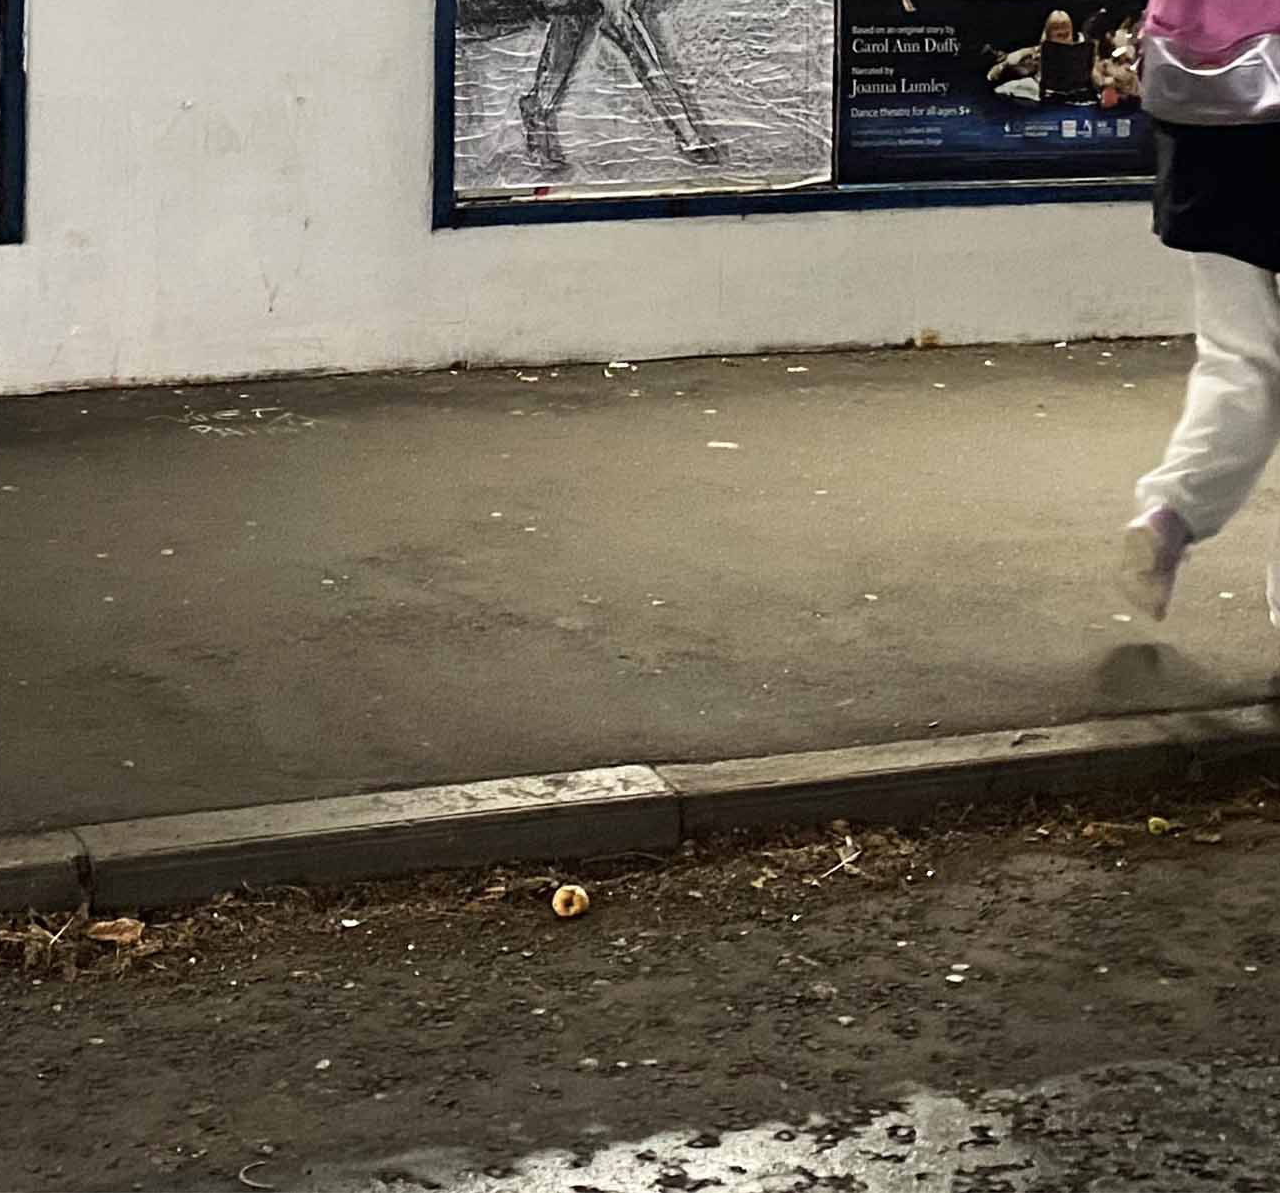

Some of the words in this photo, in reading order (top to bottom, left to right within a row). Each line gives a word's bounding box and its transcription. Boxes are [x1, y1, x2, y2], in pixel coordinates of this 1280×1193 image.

[852, 38, 889, 54] Carol
[892, 38, 921, 54] Ann
[924, 38, 961, 56] Duffy
[848, 78, 897, 99] Joanna
[901, 78, 950, 97] Lumley
